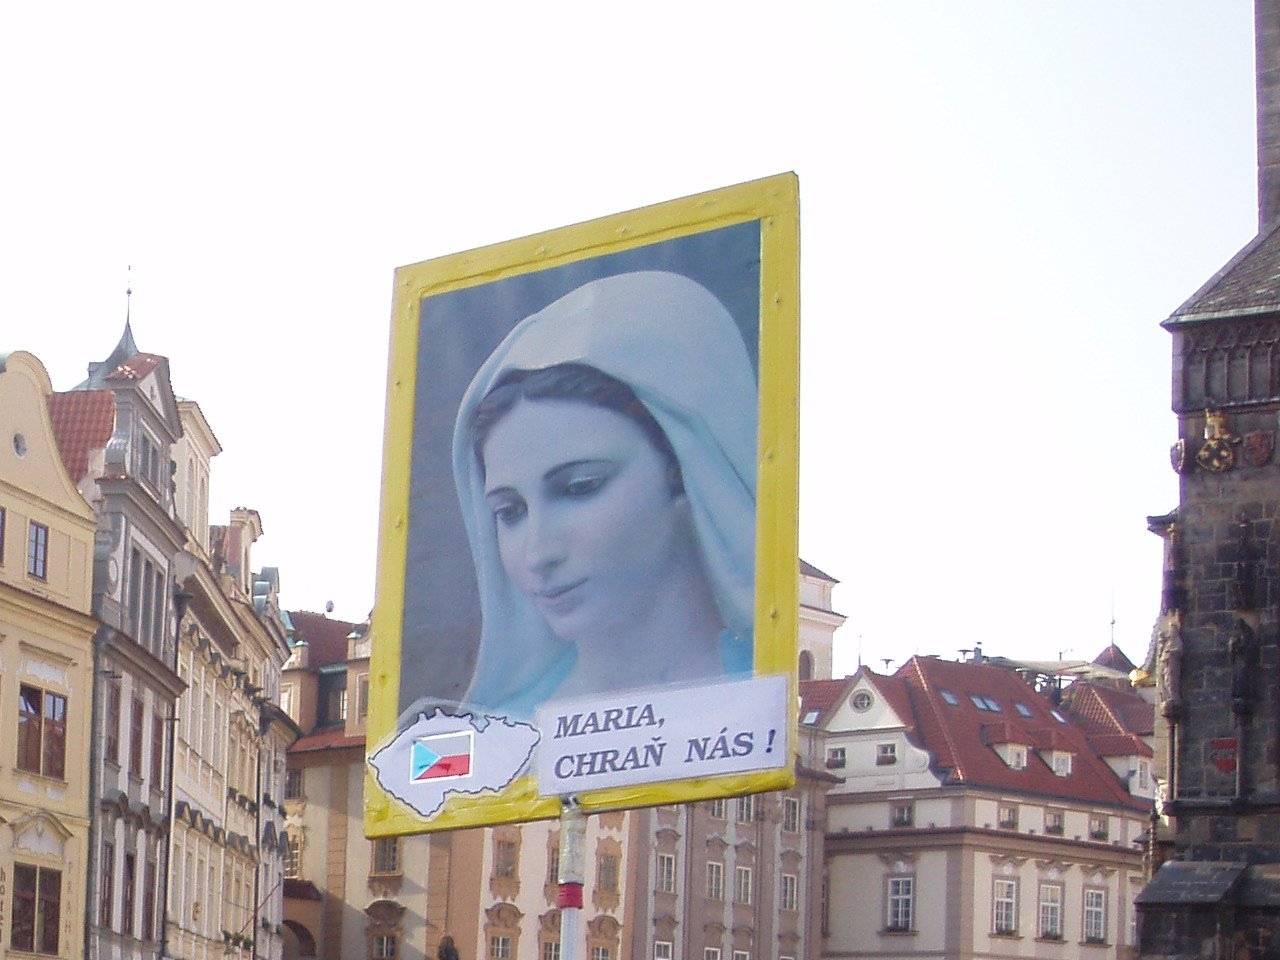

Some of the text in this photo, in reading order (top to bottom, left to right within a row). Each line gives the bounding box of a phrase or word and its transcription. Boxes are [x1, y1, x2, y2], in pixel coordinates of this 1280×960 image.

[554, 704, 665, 739] MARIA,
[554, 737, 666, 779] CHRAŇ
[685, 727, 754, 763] NÁS
